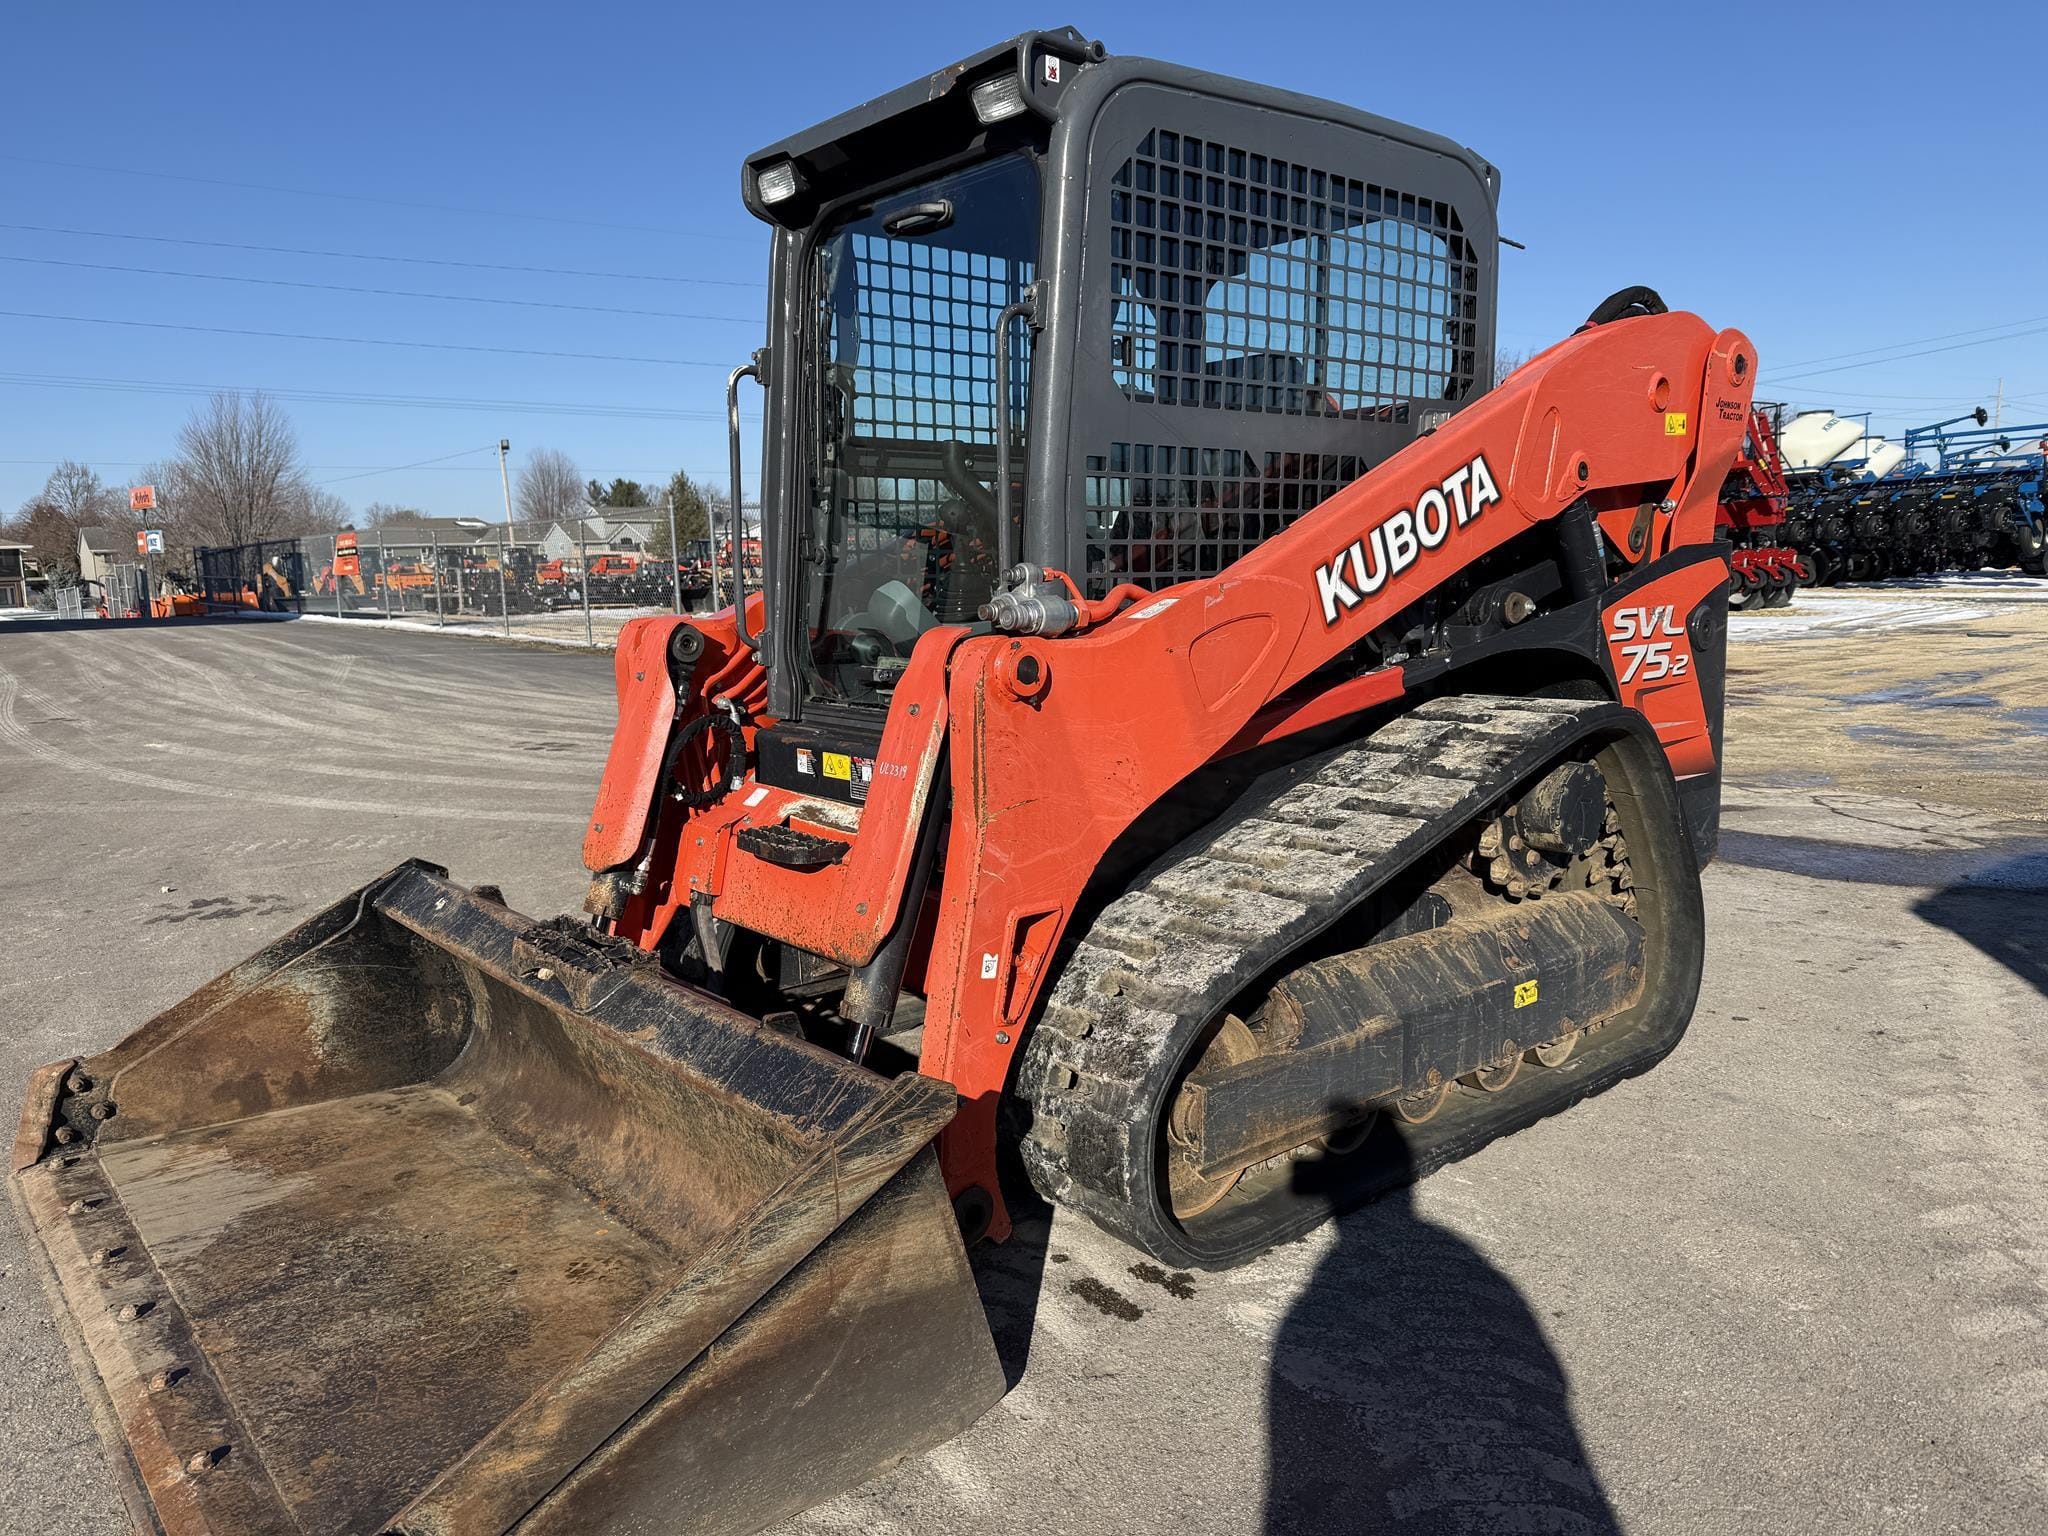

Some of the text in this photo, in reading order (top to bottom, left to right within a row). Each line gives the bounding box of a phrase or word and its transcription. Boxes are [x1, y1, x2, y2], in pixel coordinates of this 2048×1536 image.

[1715, 397, 1742, 410] JOHNSON
[1719, 408, 1744, 422] TRACTOR
[1315, 455, 1501, 625] KUBOTA
[1609, 604, 1685, 642] SVL
